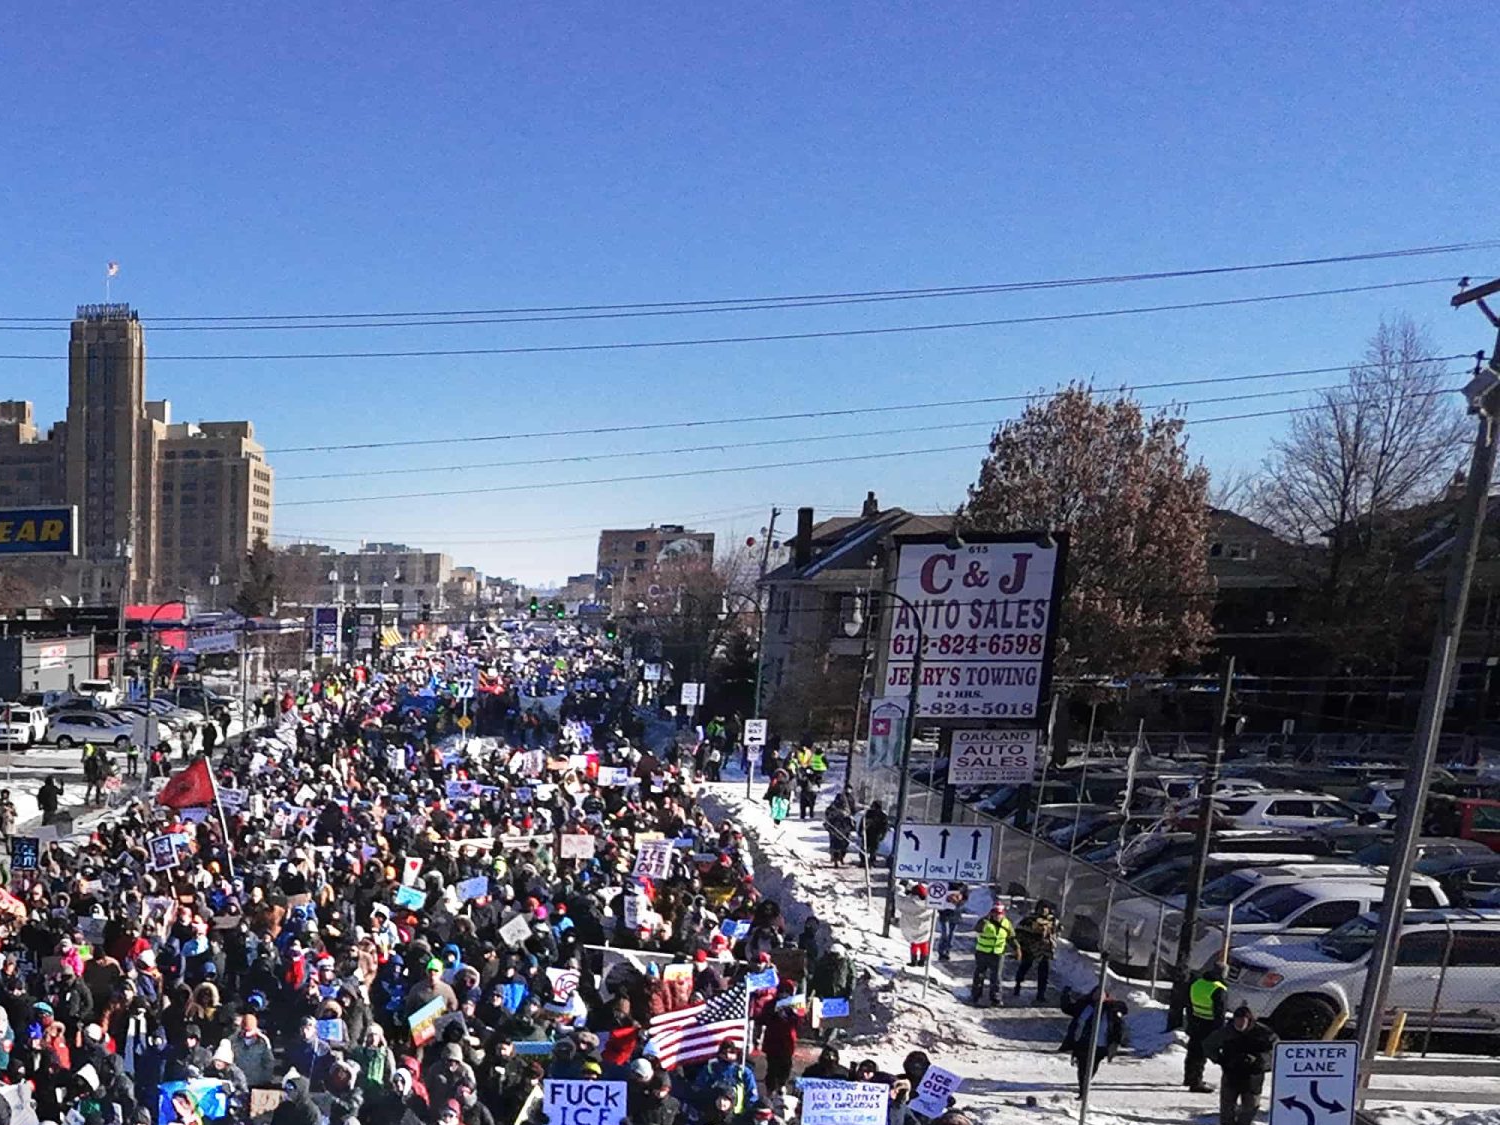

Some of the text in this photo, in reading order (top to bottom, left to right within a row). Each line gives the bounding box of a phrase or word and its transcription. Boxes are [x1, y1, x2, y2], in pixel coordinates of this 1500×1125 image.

[968, 546, 989, 554] 615
[920, 552, 1033, 595] C & J
[895, 598, 1046, 630] AUTO SALES
[888, 666, 1037, 686] JERY'S TOWING
[937, 690, 984, 699] 24 HRS.
[959, 731, 1031, 741] OAKLAND
[963, 744, 1025, 755] AUTO
[956, 756, 1028, 767] SALES
[898, 863, 923, 873] ONLY
[929, 864, 953, 874] ONLY
[963, 861, 982, 870] BUS
[959, 870, 984, 878] ONLY
[1285, 1047, 1348, 1059] CENTER
[1293, 1061, 1336, 1073] LANE
[550, 1083, 621, 1108] FUCK
